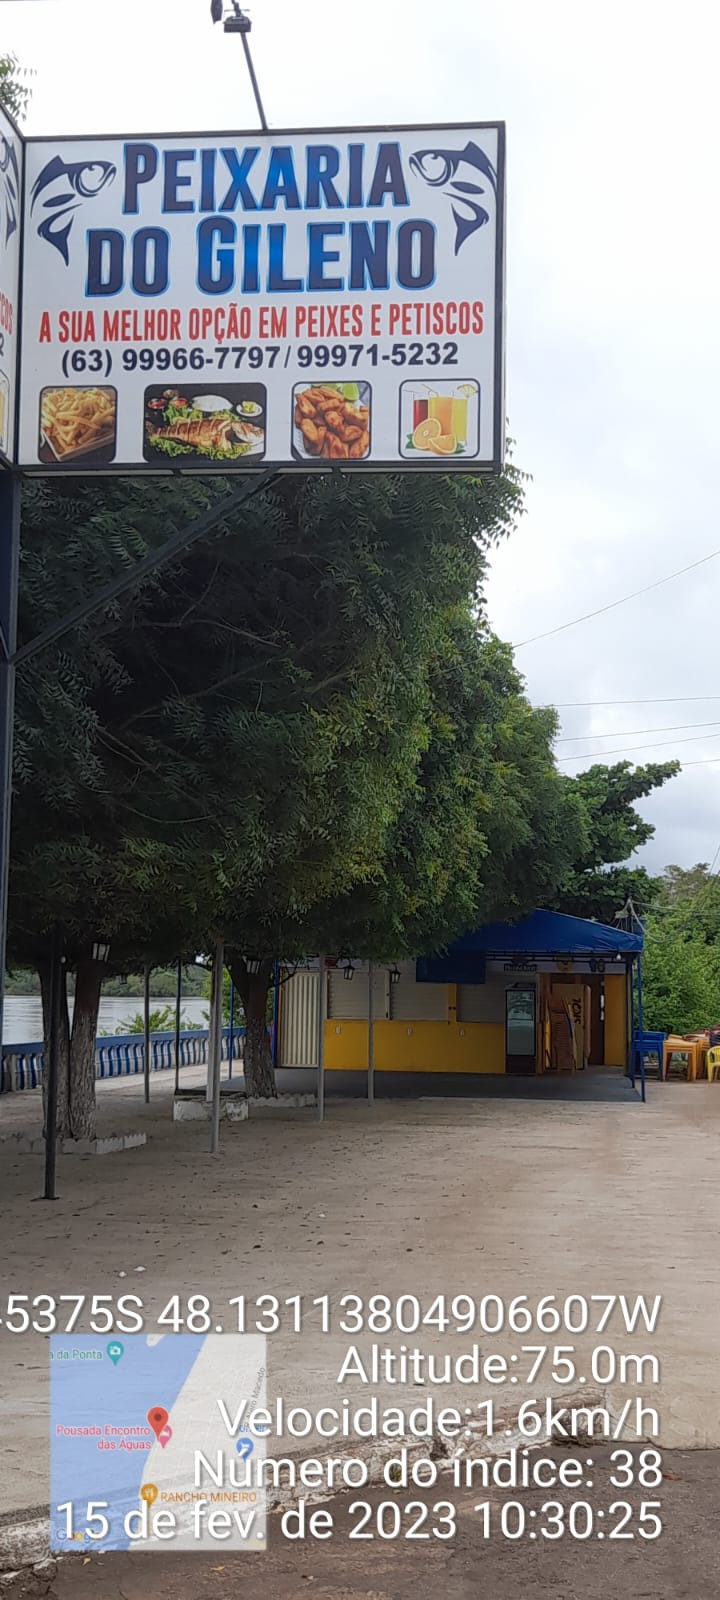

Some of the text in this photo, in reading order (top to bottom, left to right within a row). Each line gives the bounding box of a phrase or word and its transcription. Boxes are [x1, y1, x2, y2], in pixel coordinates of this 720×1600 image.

[123, 142, 410, 214] PEIXARIA
[85, 215, 436, 297] DO GILENO
[39, 301, 484, 348] A SUA MELHOR OPÇÃO EM PEIXES E PETISCOS
[61, 349, 113, 378] (63)
[122, 345, 281, 371] 99966-7797
[297, 343, 458, 368] 99971-5232
